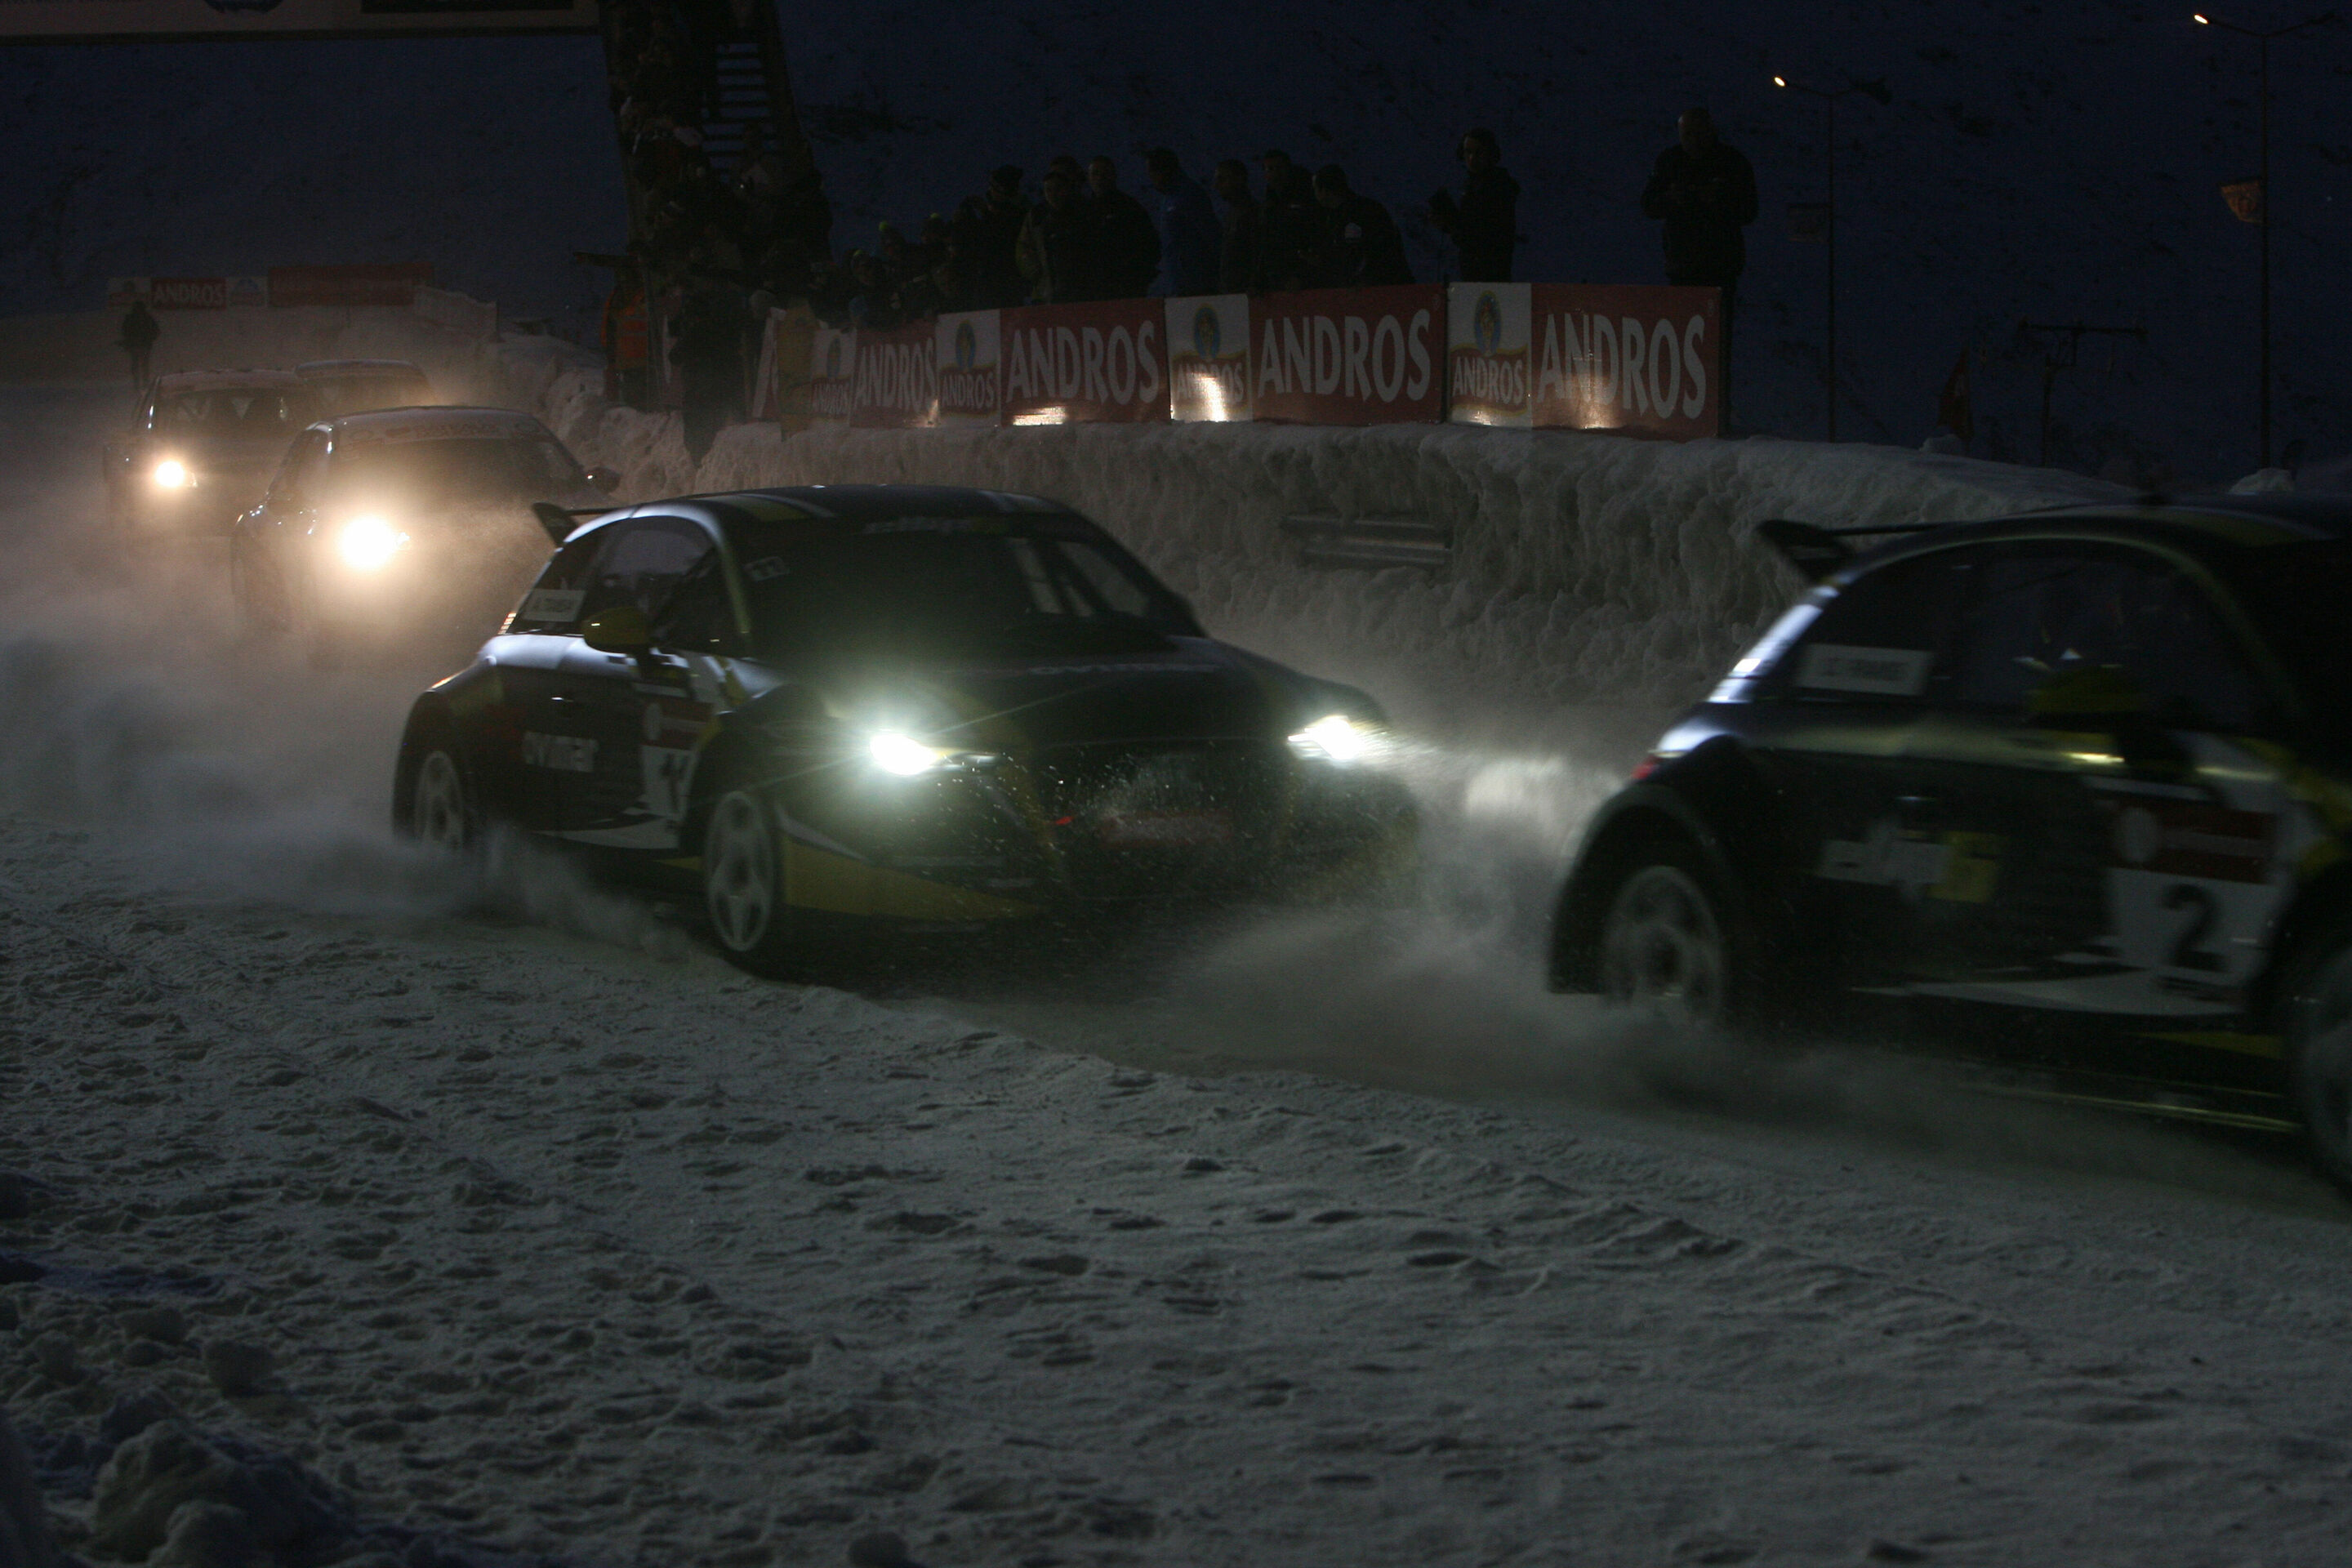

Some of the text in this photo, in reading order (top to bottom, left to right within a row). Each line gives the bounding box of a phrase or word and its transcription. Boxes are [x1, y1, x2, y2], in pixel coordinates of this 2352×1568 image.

[153, 283, 225, 307] ANDROS
[857, 336, 937, 412] ANDROS
[941, 372, 995, 410] ANDROS
[1005, 319, 1160, 405] ANDROS
[1175, 362, 1245, 404] ANDROS
[1258, 308, 1432, 403] ANDROS
[1451, 356, 1524, 405] ANDROS
[1536, 313, 1707, 420] ANDROS
[2163, 884, 2230, 973] 2
